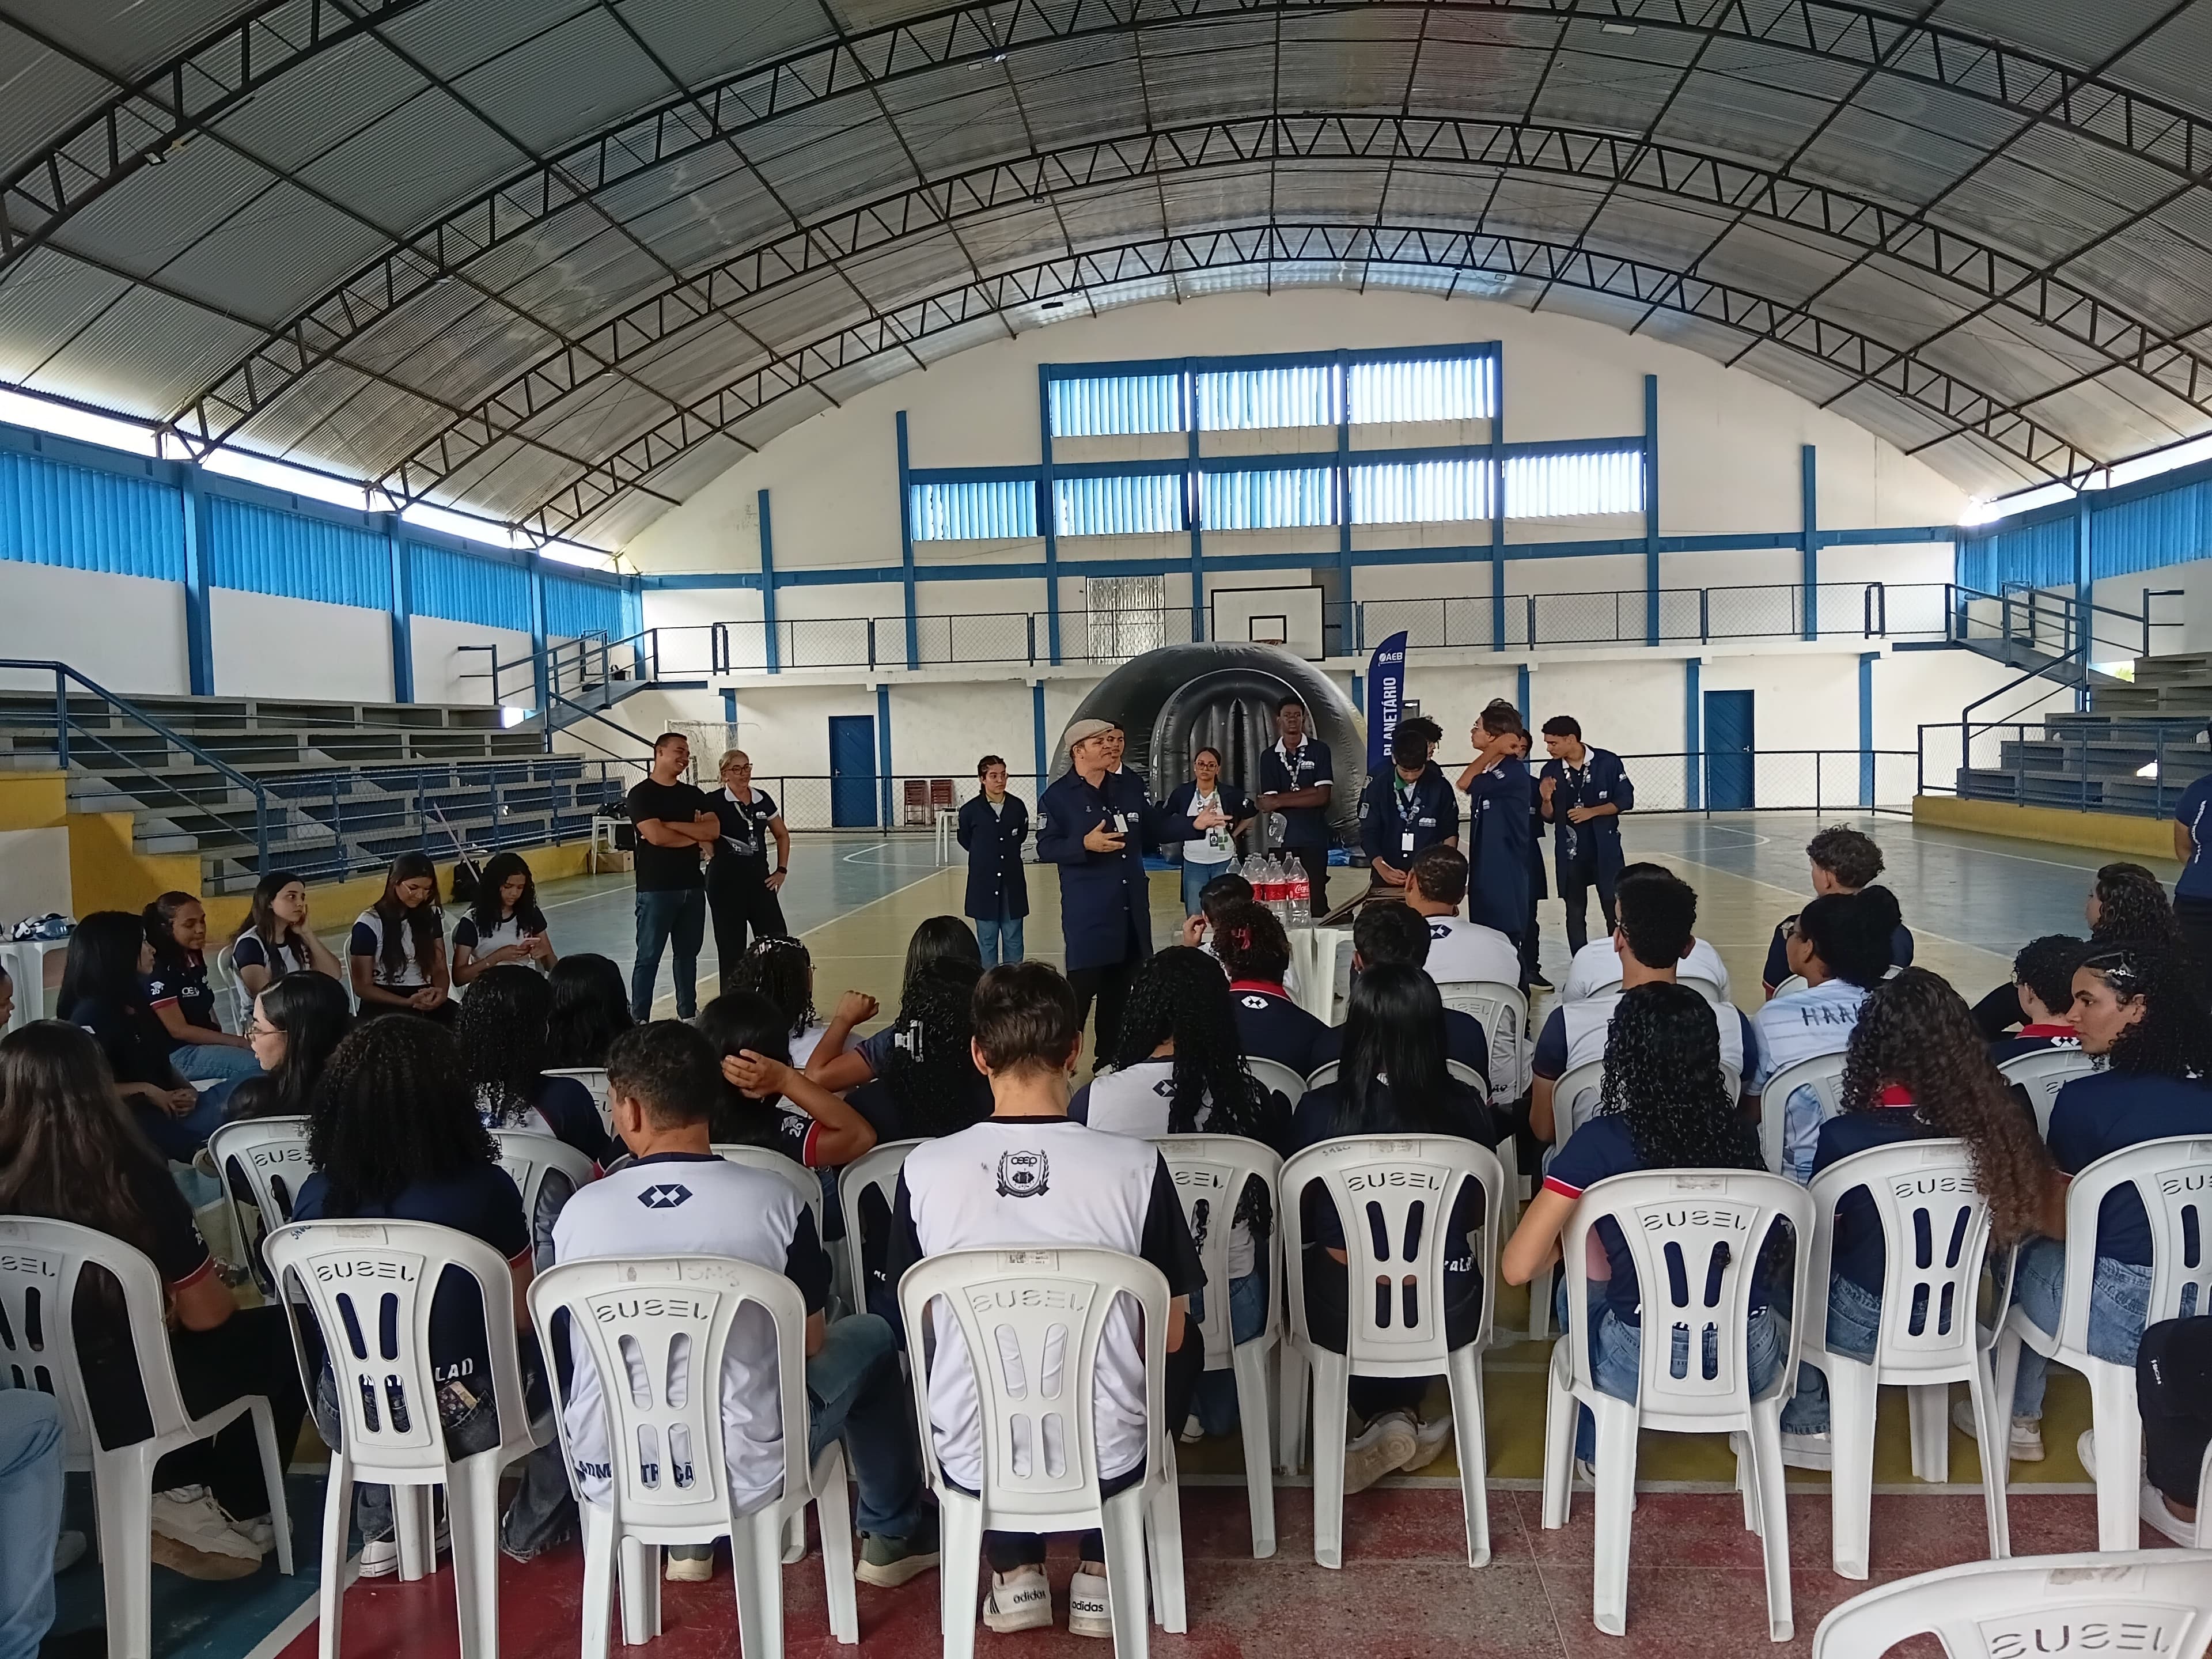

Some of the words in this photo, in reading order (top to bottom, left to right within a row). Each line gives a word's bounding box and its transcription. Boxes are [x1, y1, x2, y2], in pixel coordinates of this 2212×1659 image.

[1385, 652, 1403, 661] AEB
[789, 1123, 804, 1138] 26
[1348, 1172, 1439, 1191] SUSEL
[1644, 1210, 1747, 1230] SUSEL
[317, 1261, 414, 1281] SUSEL
[972, 1289, 1084, 1313] SUSEL
[596, 1299, 709, 1323] SUSEL
[1013, 1588, 1047, 1604] adidas
[1071, 1600, 1104, 1612] adidas
[1991, 1623, 2170, 1659] SUSEL
